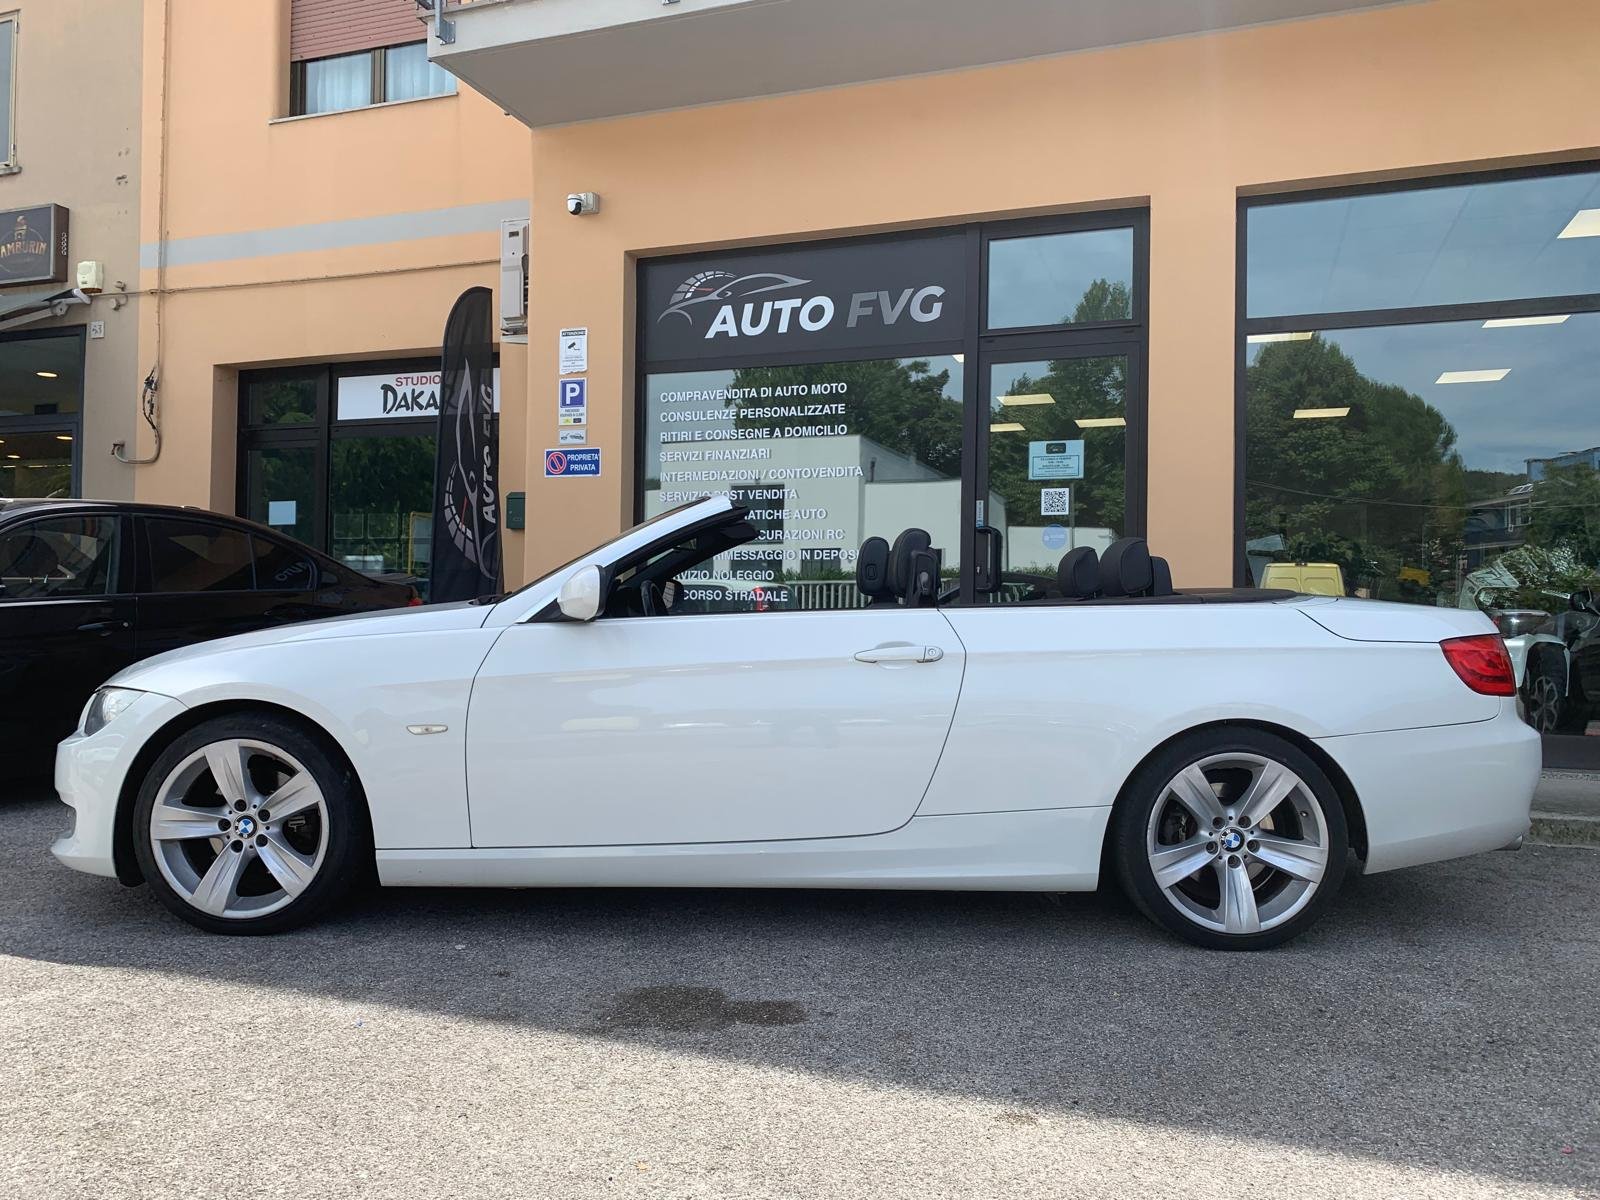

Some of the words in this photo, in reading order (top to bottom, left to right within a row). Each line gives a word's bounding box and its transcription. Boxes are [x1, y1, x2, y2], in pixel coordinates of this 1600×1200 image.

[0, 240, 48, 258] AMBURIN
[704, 295, 835, 339] AUTO
[846, 285, 946, 328] FVG
[395, 374, 442, 387] STUDIO
[380, 383, 440, 415] DAKA
[566, 383, 580, 405] P
[660, 387, 758, 403] COMPRAVENDITA
[760, 386, 773, 397] DI
[775, 385, 808, 397] AUTO
[811, 382, 847, 395] MOTO
[660, 408, 737, 423] CONSULENZE
[740, 403, 846, 419] PERSONALIZZATE
[660, 431, 692, 442] RITIRI
[694, 431, 702, 441] E
[705, 428, 770, 441] CONSEGNE
[772, 427, 782, 438] A
[784, 424, 848, 438] DOMICILIO
[659, 451, 703, 463] SERVIZI
[706, 448, 771, 460] FINANZIARI
[570, 463, 596, 471] PRIVATA
[660, 469, 759, 483] INTERMEDIAZIONI
[769, 465, 864, 480] CONTOVENDITA
[482, 445, 497, 525] AUTO
[747, 488, 798, 500] VENDITA
[744, 509, 790, 520] ATICHE
[794, 508, 827, 520] AUTO
[756, 529, 823, 540] CURAZIONI
[827, 528, 845, 539] RC
[800, 549, 811, 560] IN
[814, 549, 859, 560] DEPOSI
[673, 570, 710, 580] VIZIO
[713, 570, 774, 581] NOLEGGIO
[684, 589, 723, 601] CORSO
[725, 589, 789, 601] STRADALE
